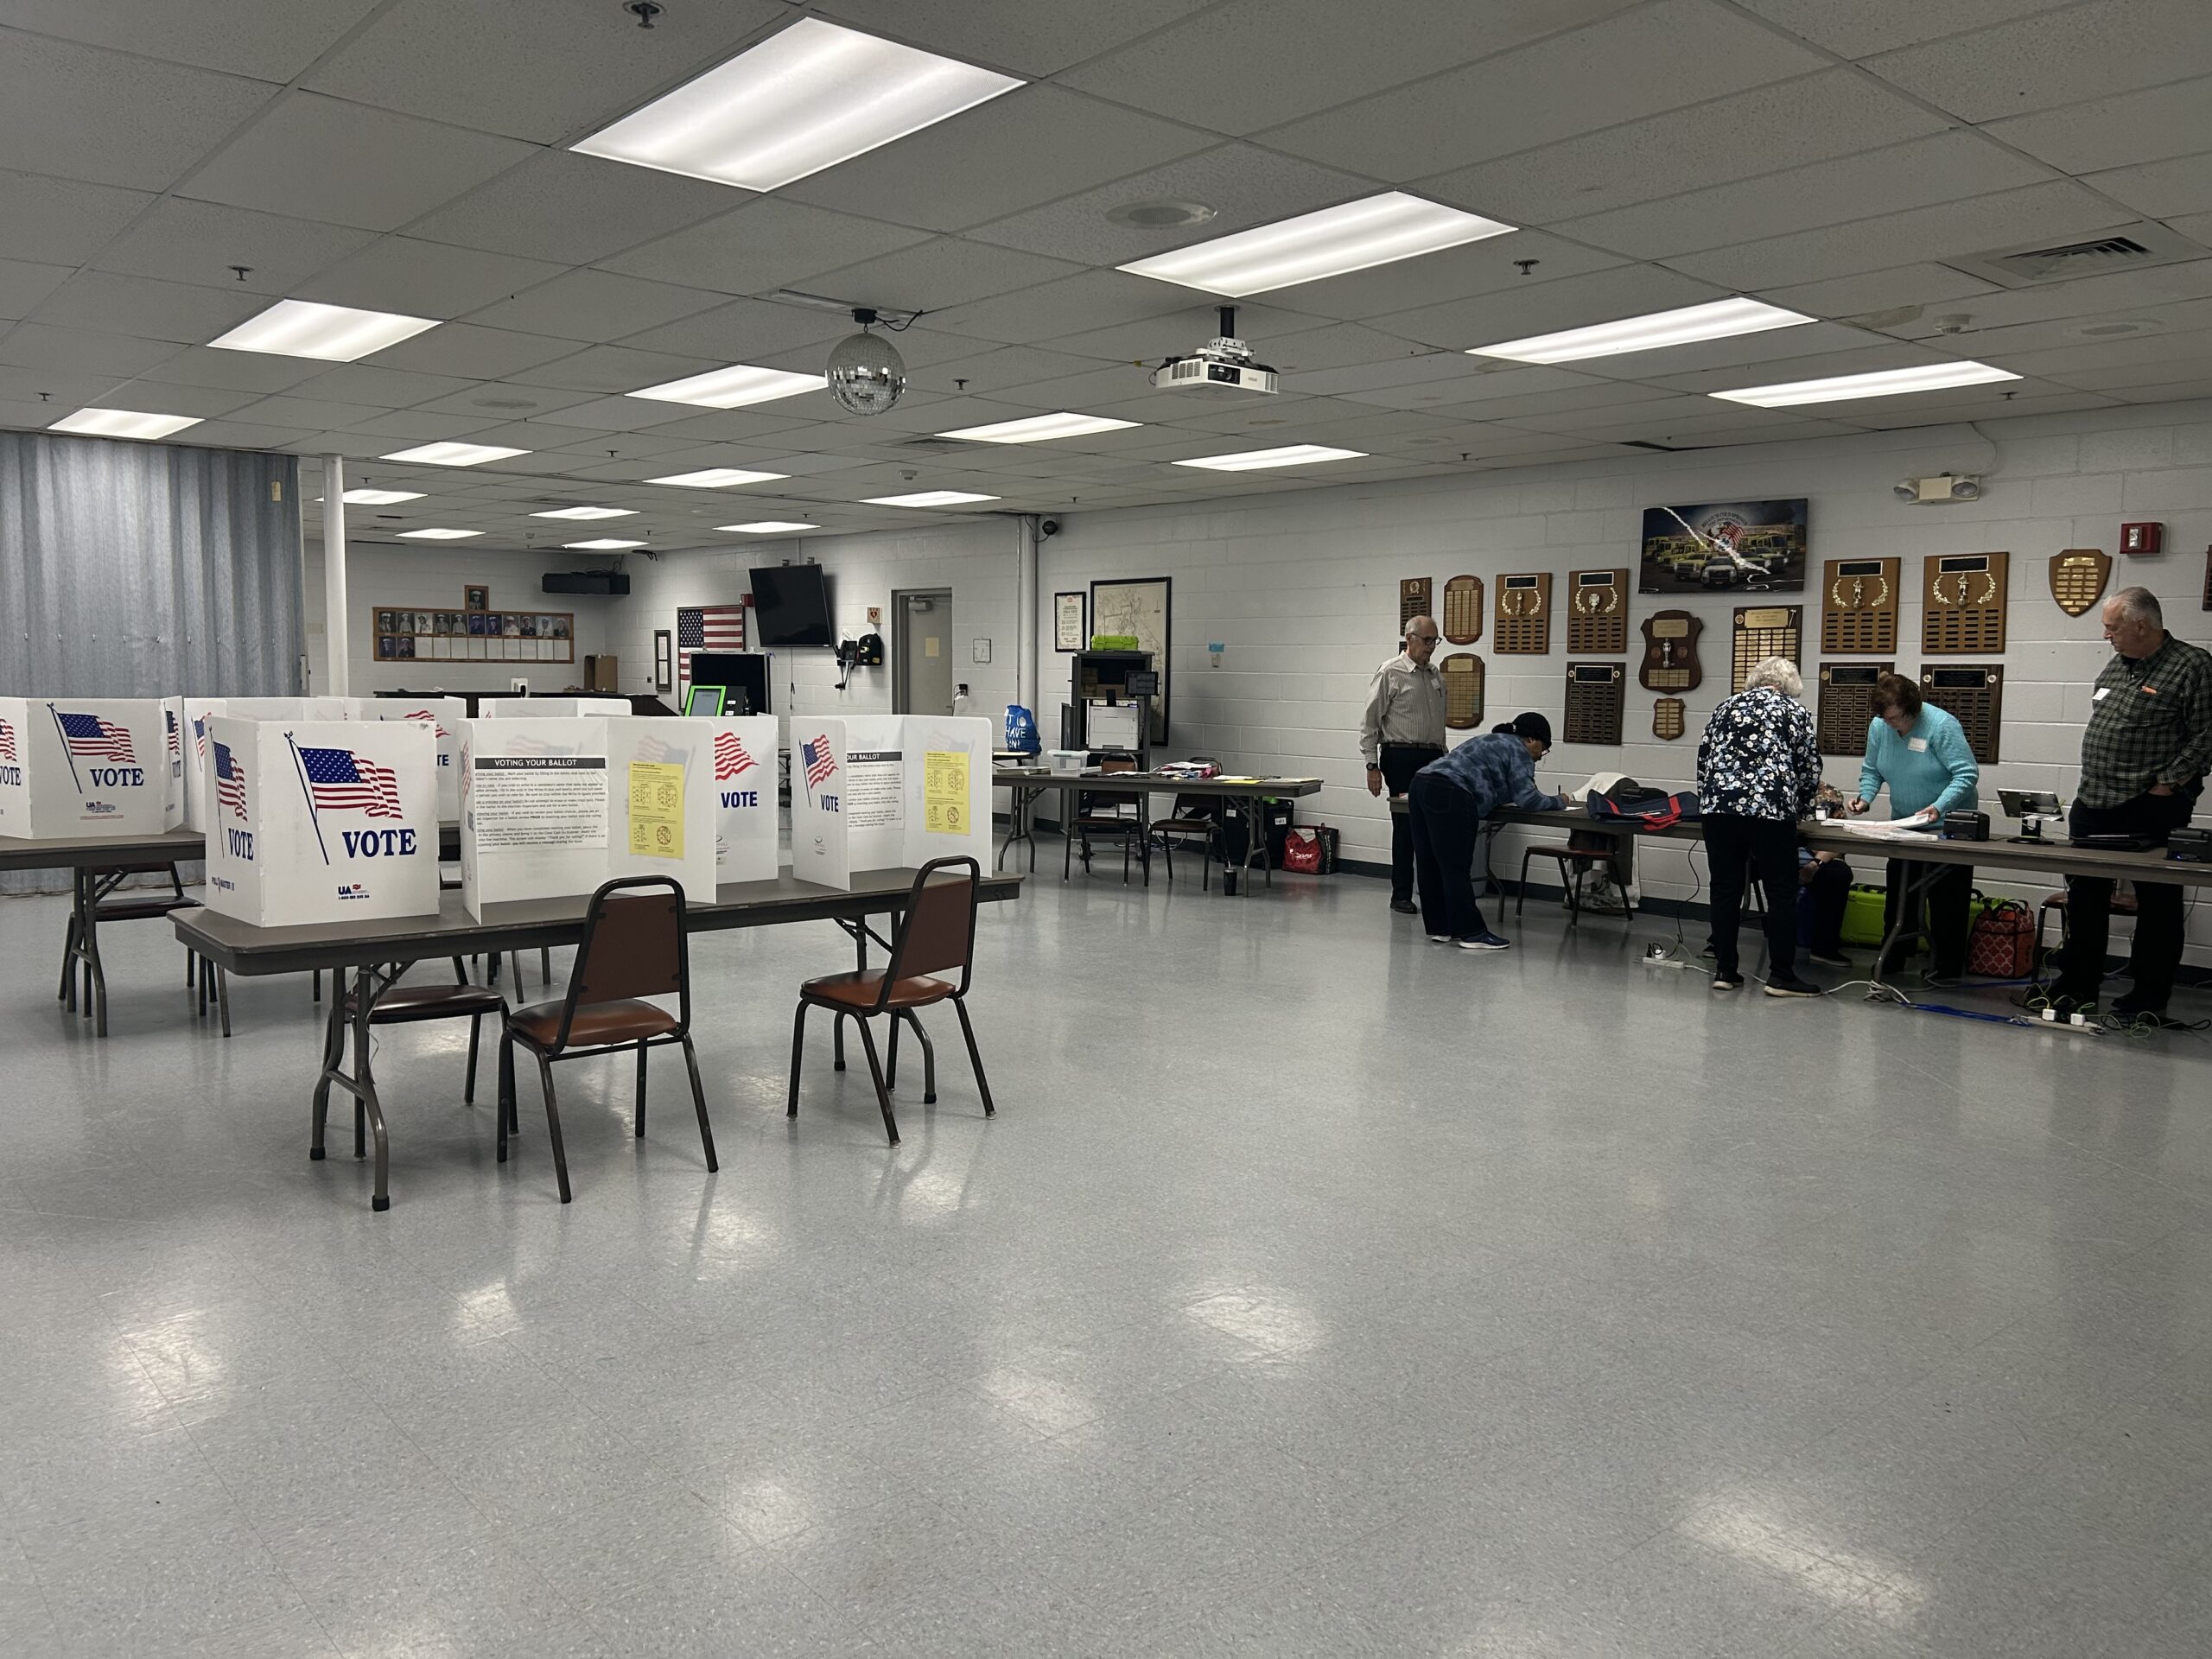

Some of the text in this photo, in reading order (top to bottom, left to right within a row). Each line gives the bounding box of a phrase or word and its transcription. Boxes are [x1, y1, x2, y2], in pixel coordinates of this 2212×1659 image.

[437, 754, 449, 766] TE
[90, 768, 144, 787] VOTE
[721, 791, 758, 808] VOTE
[820, 794, 839, 812] VOTE
[228, 827, 254, 861] VOTE
[342, 828, 417, 858] VOTE
[338, 886, 352, 895] UA
